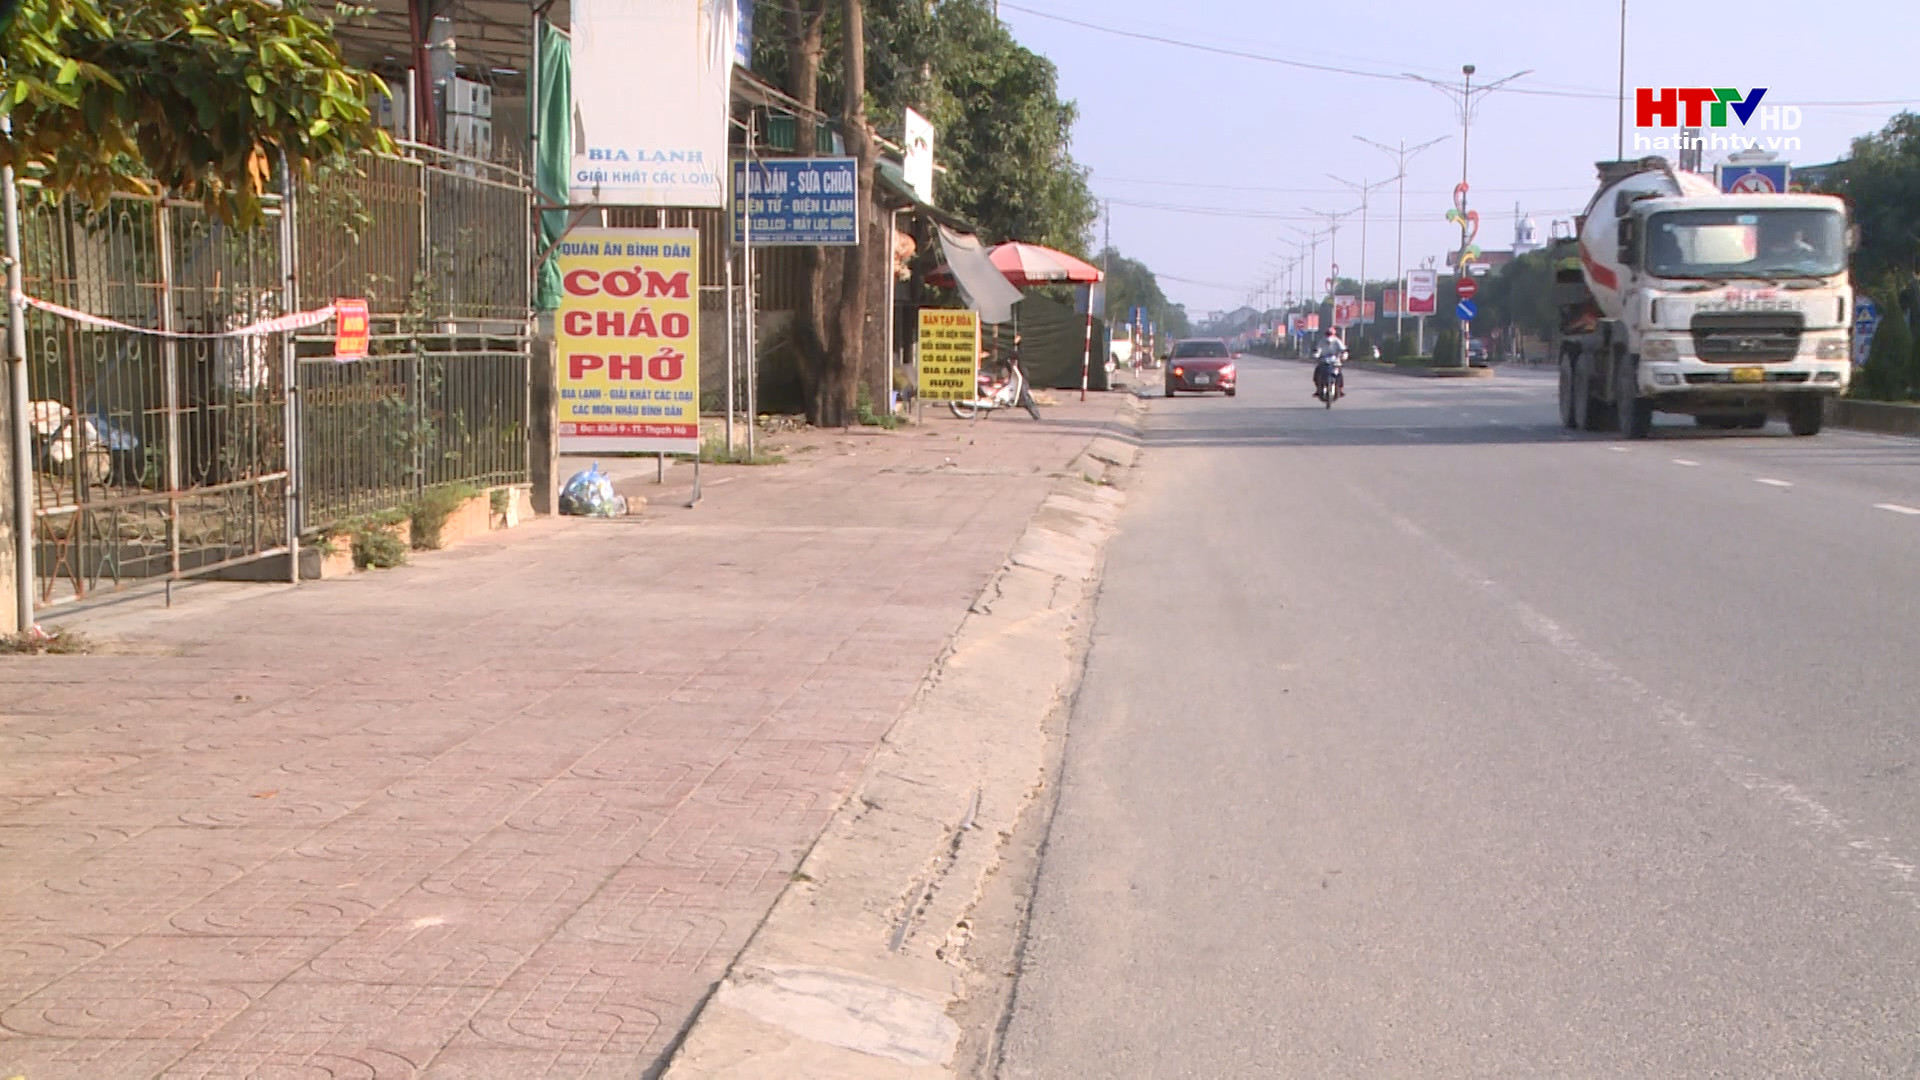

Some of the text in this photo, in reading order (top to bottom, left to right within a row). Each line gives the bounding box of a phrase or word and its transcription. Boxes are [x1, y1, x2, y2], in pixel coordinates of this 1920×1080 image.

[588, 148, 703, 165] BIA LẠNH
[612, 170, 648, 183] KHÁT
[652, 170, 677, 184] CÁC
[563, 265, 690, 298] CƠM
[564, 307, 689, 338] CHÁO
[569, 347, 684, 381] PHỞ
